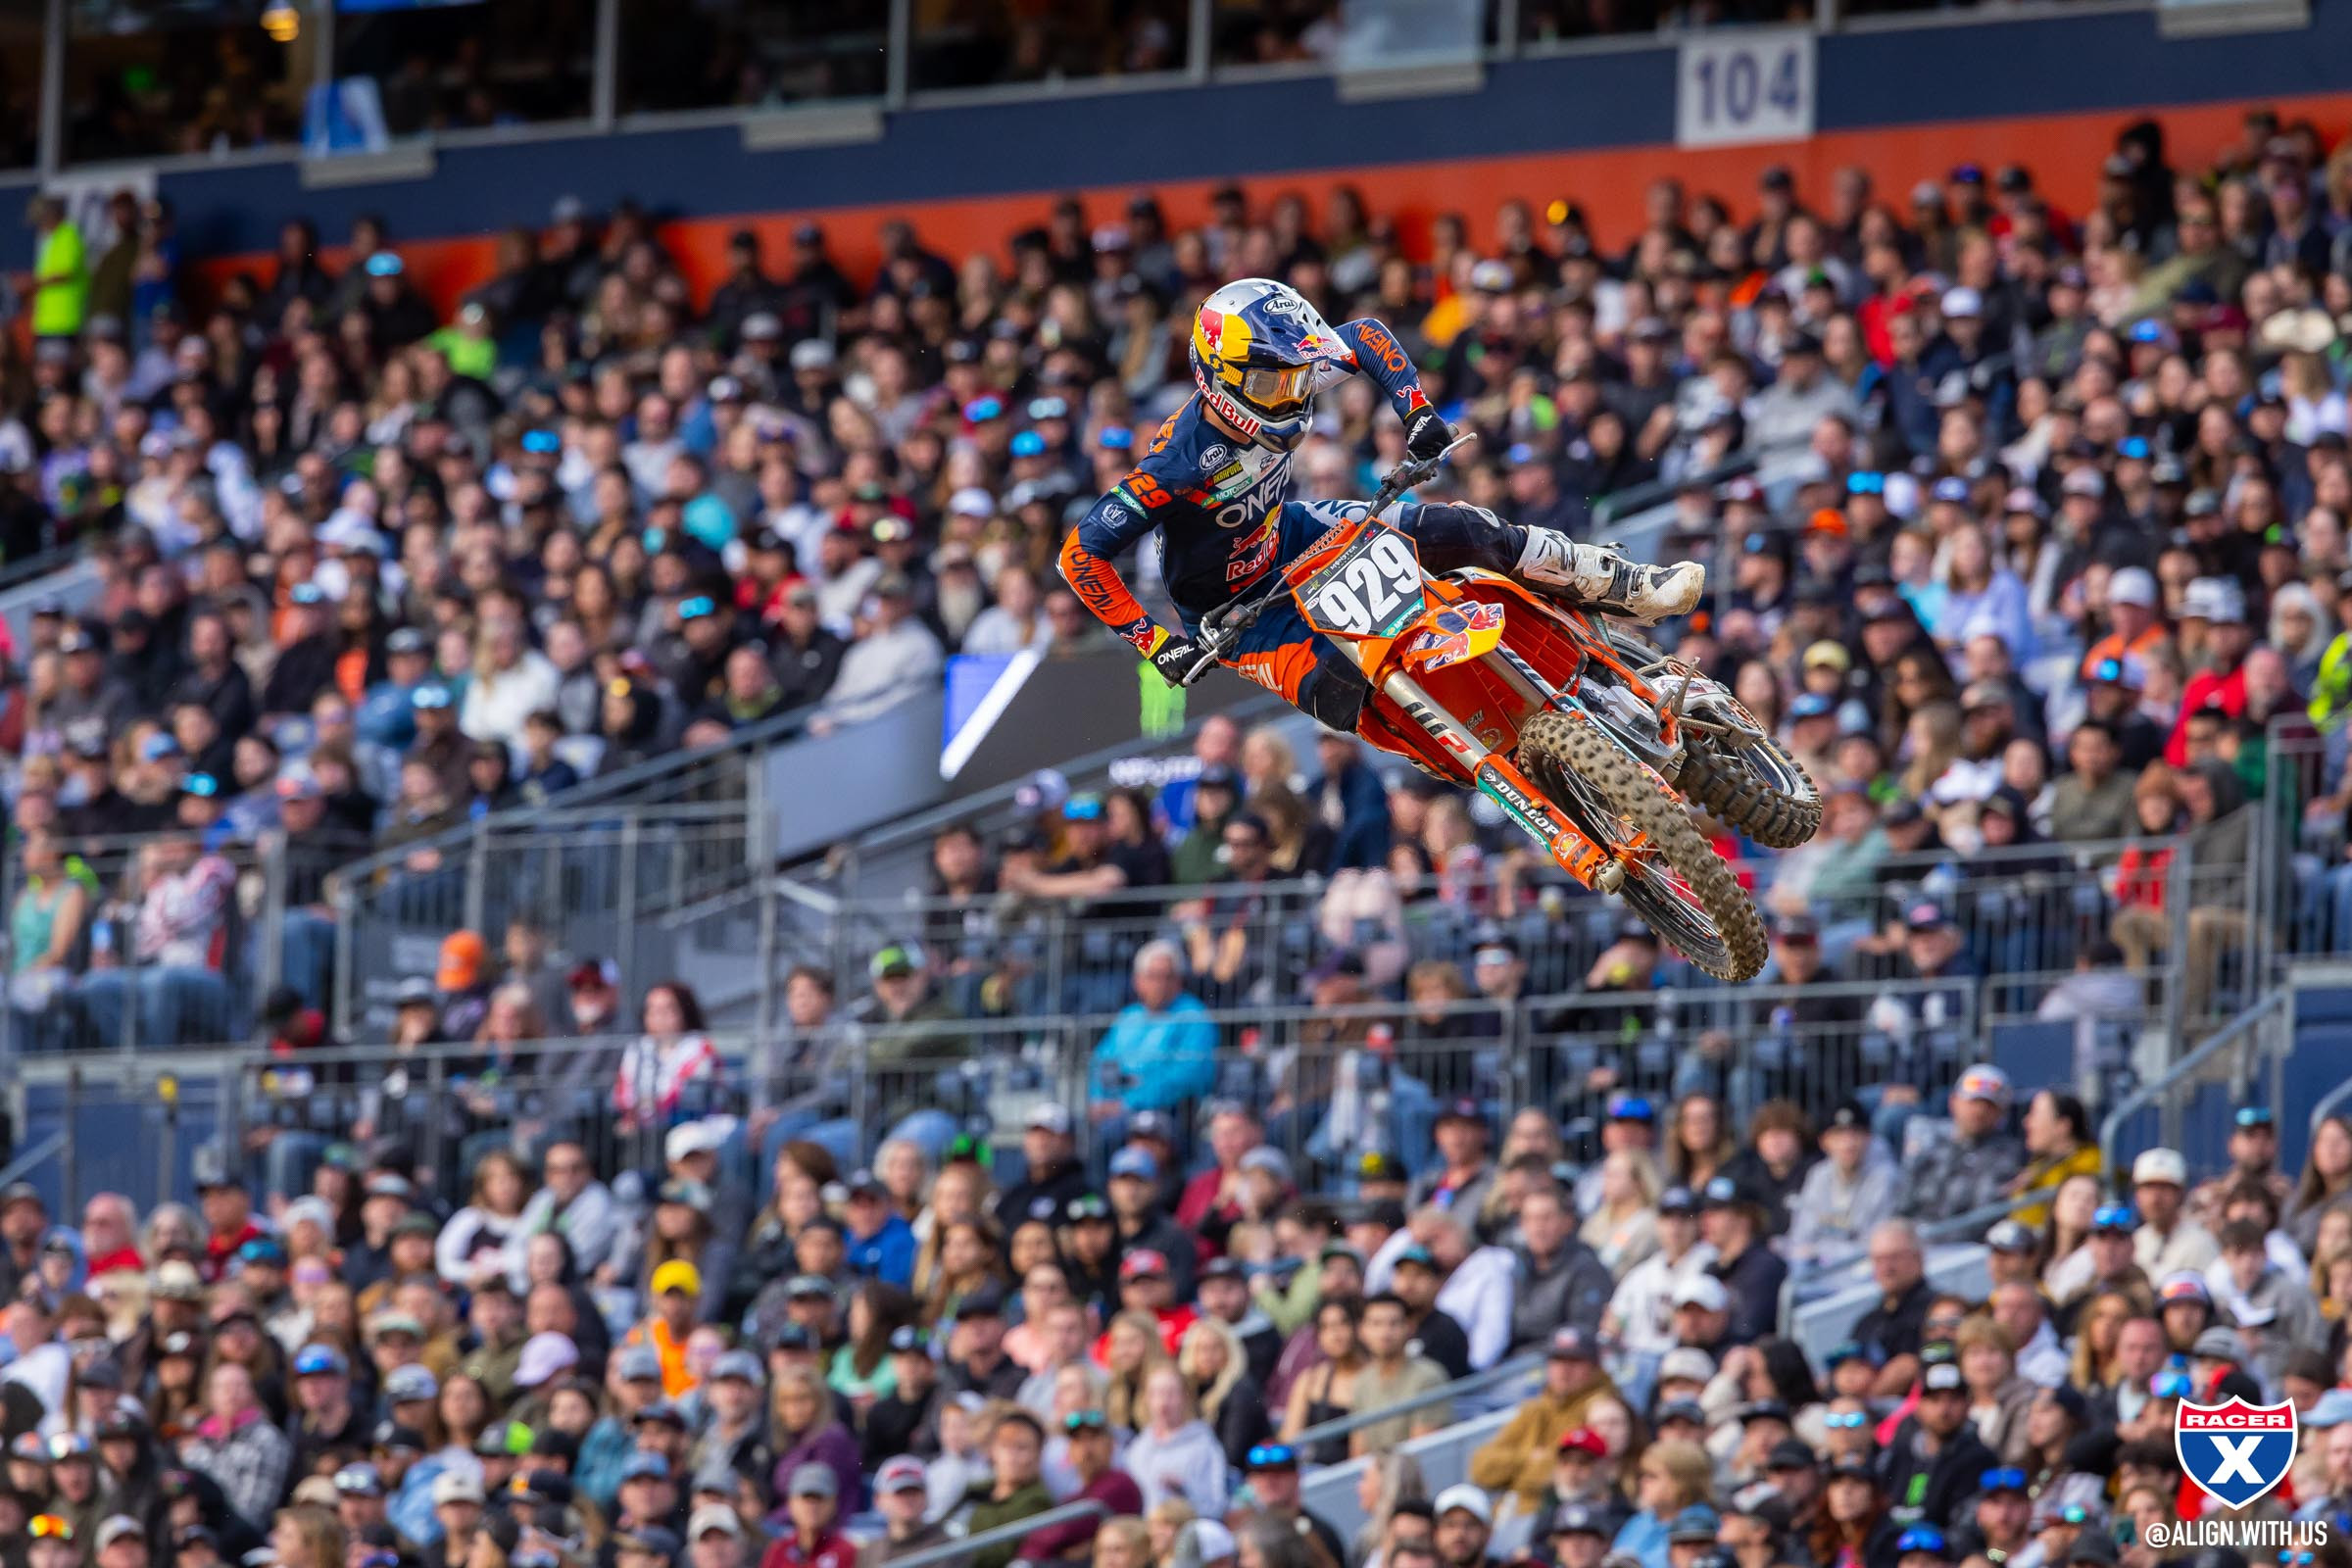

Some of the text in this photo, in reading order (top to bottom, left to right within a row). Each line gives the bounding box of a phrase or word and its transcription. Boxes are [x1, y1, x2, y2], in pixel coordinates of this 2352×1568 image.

[1694, 48, 1799, 127] 104
[1267, 299, 1296, 312] Arai
[1300, 344, 1344, 360] Red Bull
[1196, 365, 1224, 410] Red
[1220, 399, 1261, 437] Bull
[1203, 446, 1224, 466] Arai
[1124, 467, 1173, 509] 29
[1226, 541, 1266, 581] Red
[1330, 545, 1358, 570] MONSTER
[1319, 533, 1422, 636] 929
[1494, 781, 1560, 838] DUNLOP
[1499, 803, 1547, 847] MOTOREX
